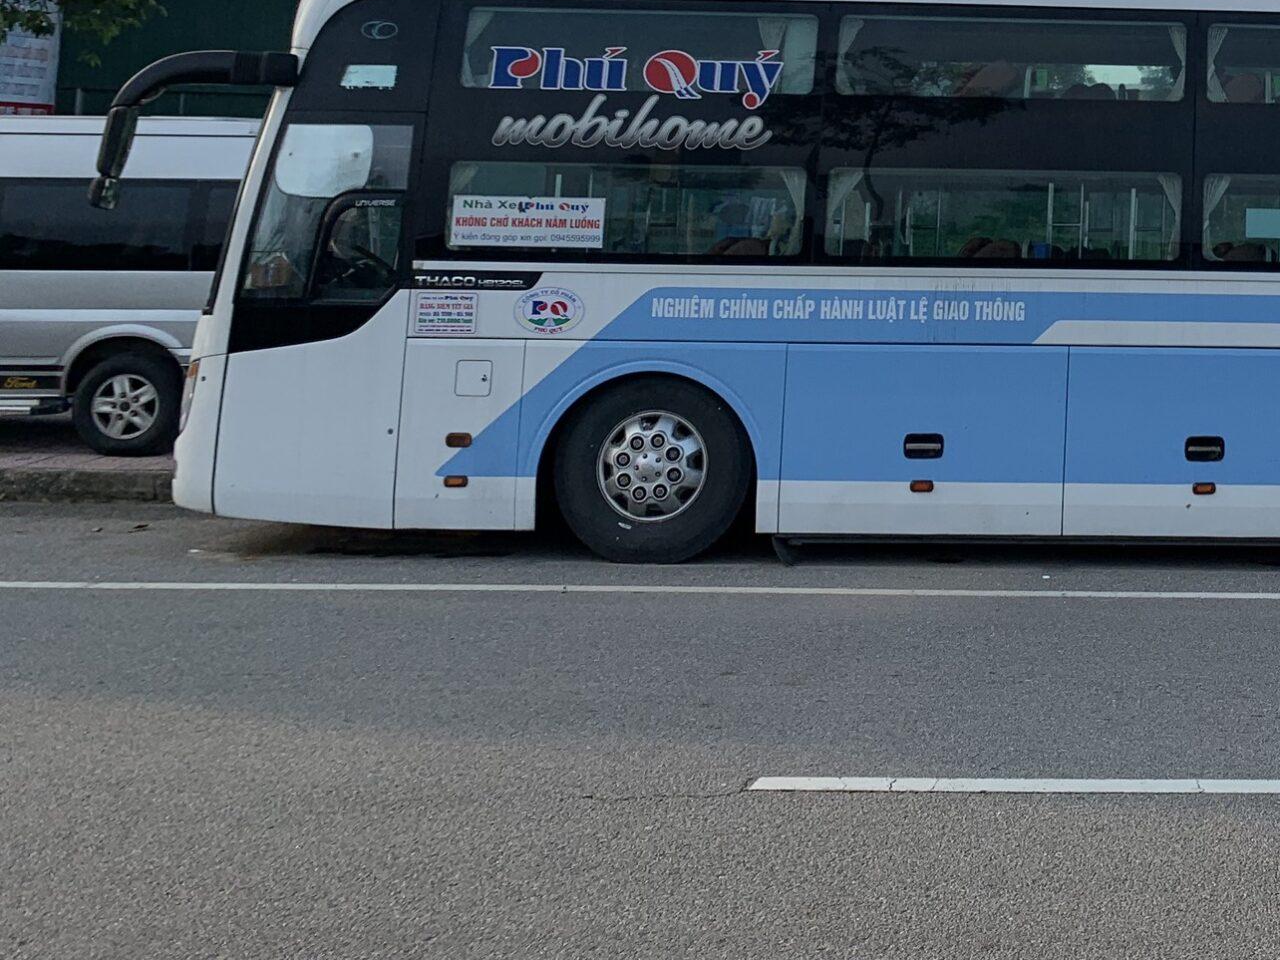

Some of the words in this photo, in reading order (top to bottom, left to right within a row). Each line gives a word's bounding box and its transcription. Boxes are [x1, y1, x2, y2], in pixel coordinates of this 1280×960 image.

[488, 45, 628, 91] Phú
[642, 49, 784, 110] Quý
[491, 94, 773, 150] mobihome
[462, 200, 493, 209] Nhà
[498, 200, 518, 210] Xe
[558, 201, 590, 214] Quý
[455, 214, 488, 227] KHÔNG
[414, 275, 476, 287] THACO
[651, 294, 715, 320] NGHIÊM
[719, 293, 769, 320] CHỈNH
[773, 293, 816, 320] CHẤP
[820, 297, 865, 321] HÀNH
[868, 296, 906, 323] LUẬT
[909, 296, 928, 324] LỆ
[933, 300, 970, 321] GIAO
[974, 297, 1026, 322] THÔNG
